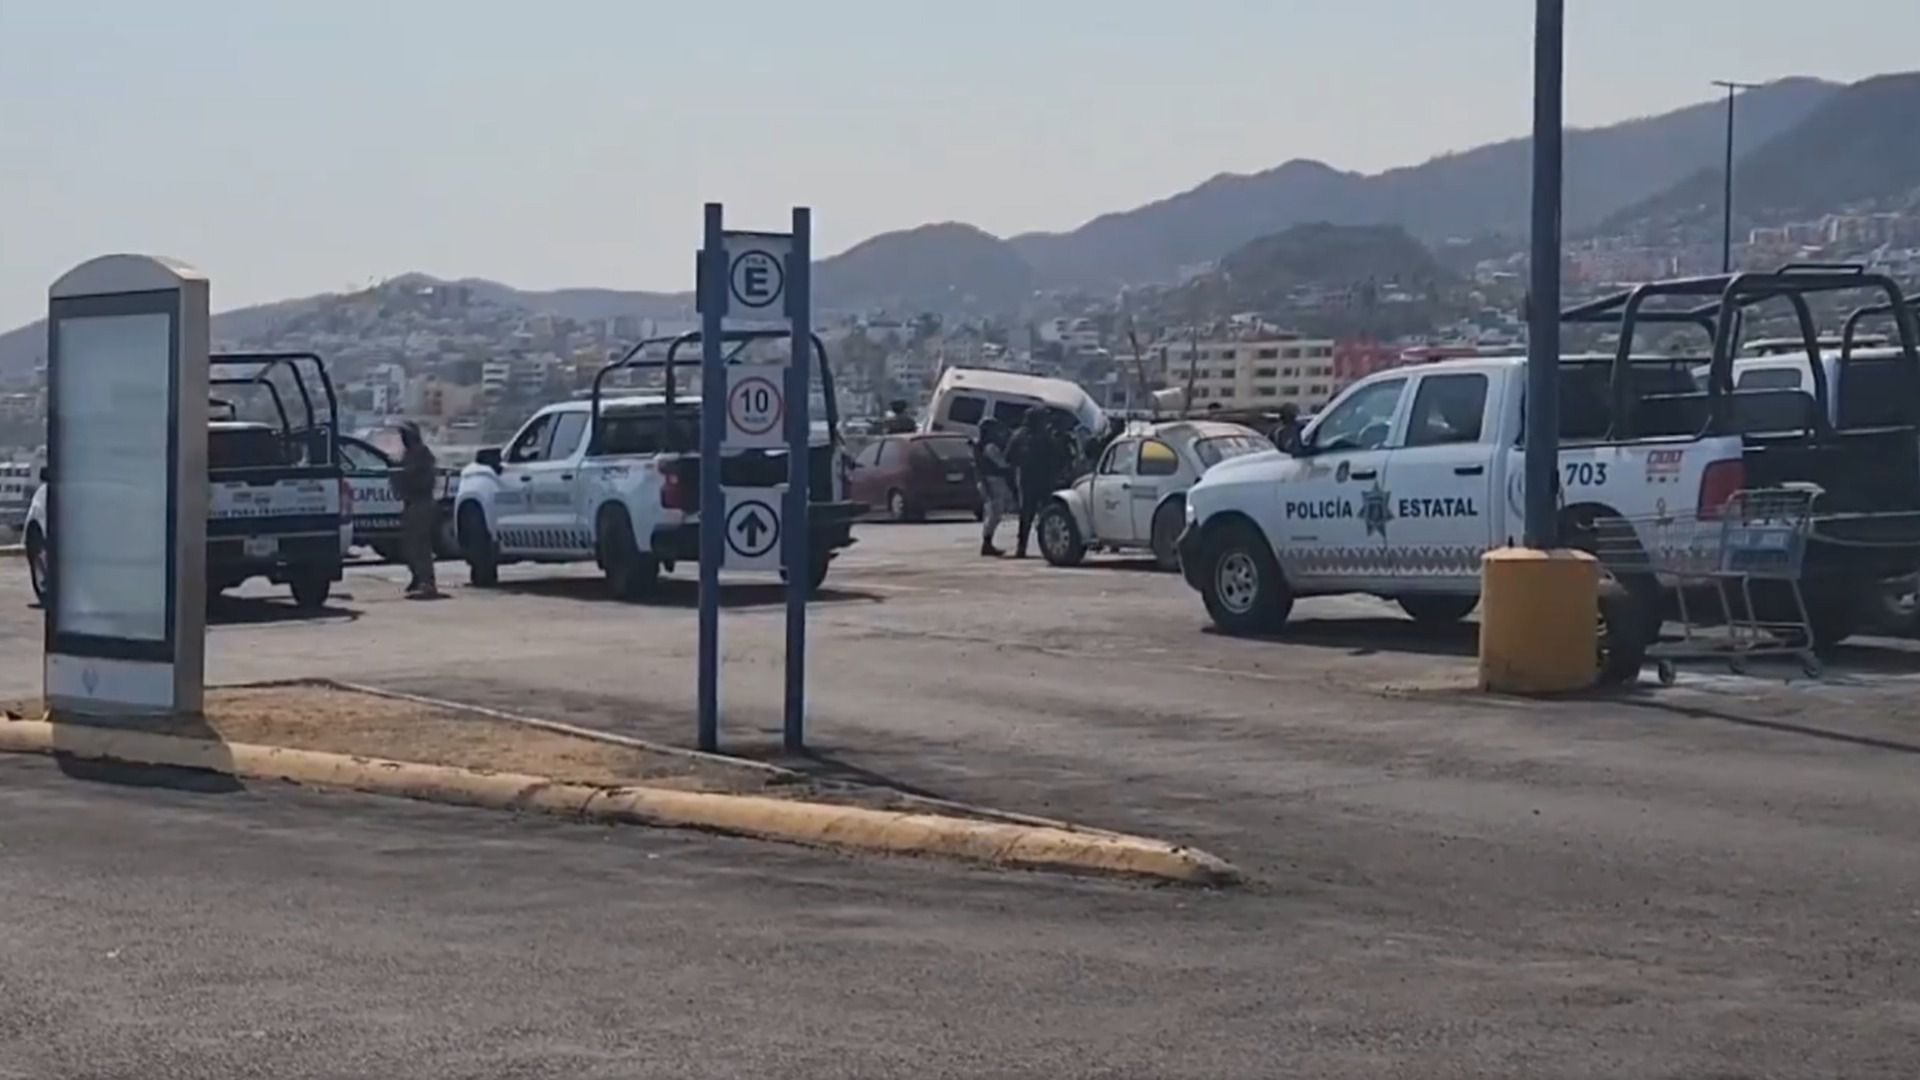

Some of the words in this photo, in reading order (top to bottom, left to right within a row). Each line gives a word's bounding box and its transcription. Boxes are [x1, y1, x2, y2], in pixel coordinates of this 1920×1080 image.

[745, 267, 768, 296] E
[740, 388, 768, 413] 10
[1566, 462, 1607, 485] 703
[1286, 497, 1353, 519] POLICÍA
[1399, 498, 1478, 517] ESTATAL
